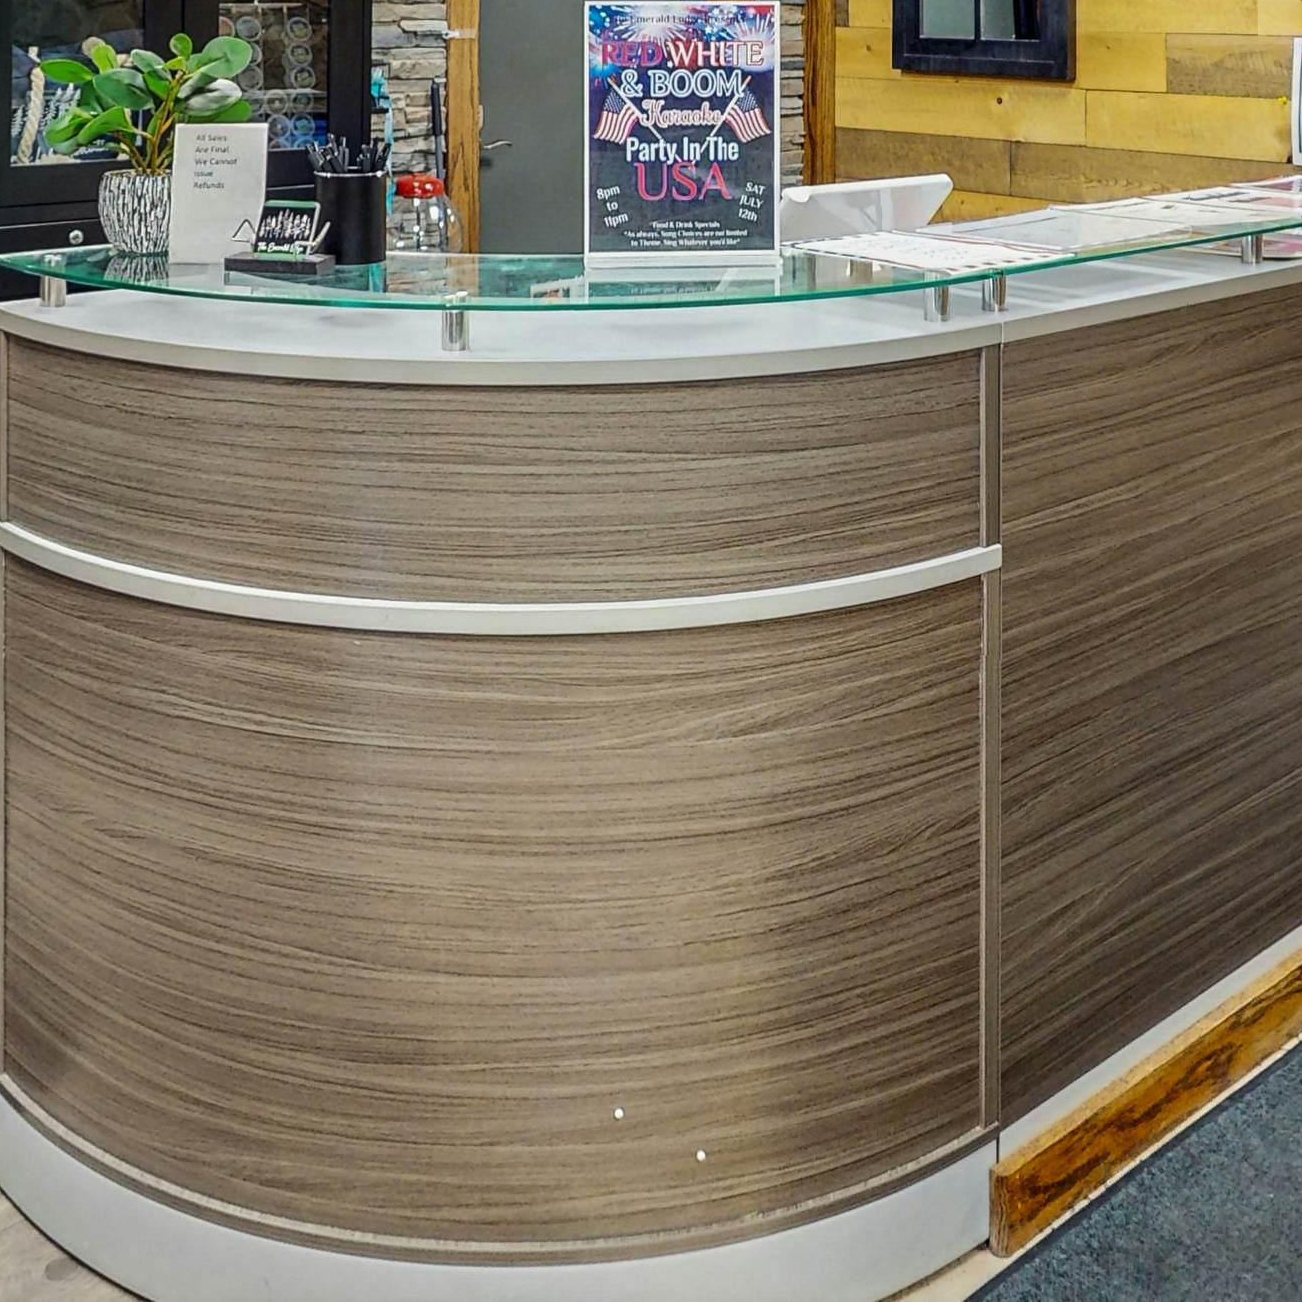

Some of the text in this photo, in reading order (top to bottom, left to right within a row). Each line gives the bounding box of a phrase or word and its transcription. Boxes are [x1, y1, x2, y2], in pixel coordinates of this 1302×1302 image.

[601, 40, 765, 67] RED WHITE
[619, 69, 745, 98] & BOOM
[640, 99, 723, 128] Karaoke
[626, 136, 739, 165] Party In The
[210, 157, 238, 166] Cannot
[193, 181, 225, 189] Refunds
[634, 162, 732, 200] USA
[745, 181, 767, 195] SAT
[596, 184, 621, 200] 8pm
[606, 200, 619, 212] to
[739, 194, 765, 210] JULY
[603, 212, 629, 229] 11pm
[738, 208, 758, 223] 12th
[676, 221, 694, 229] Drink
